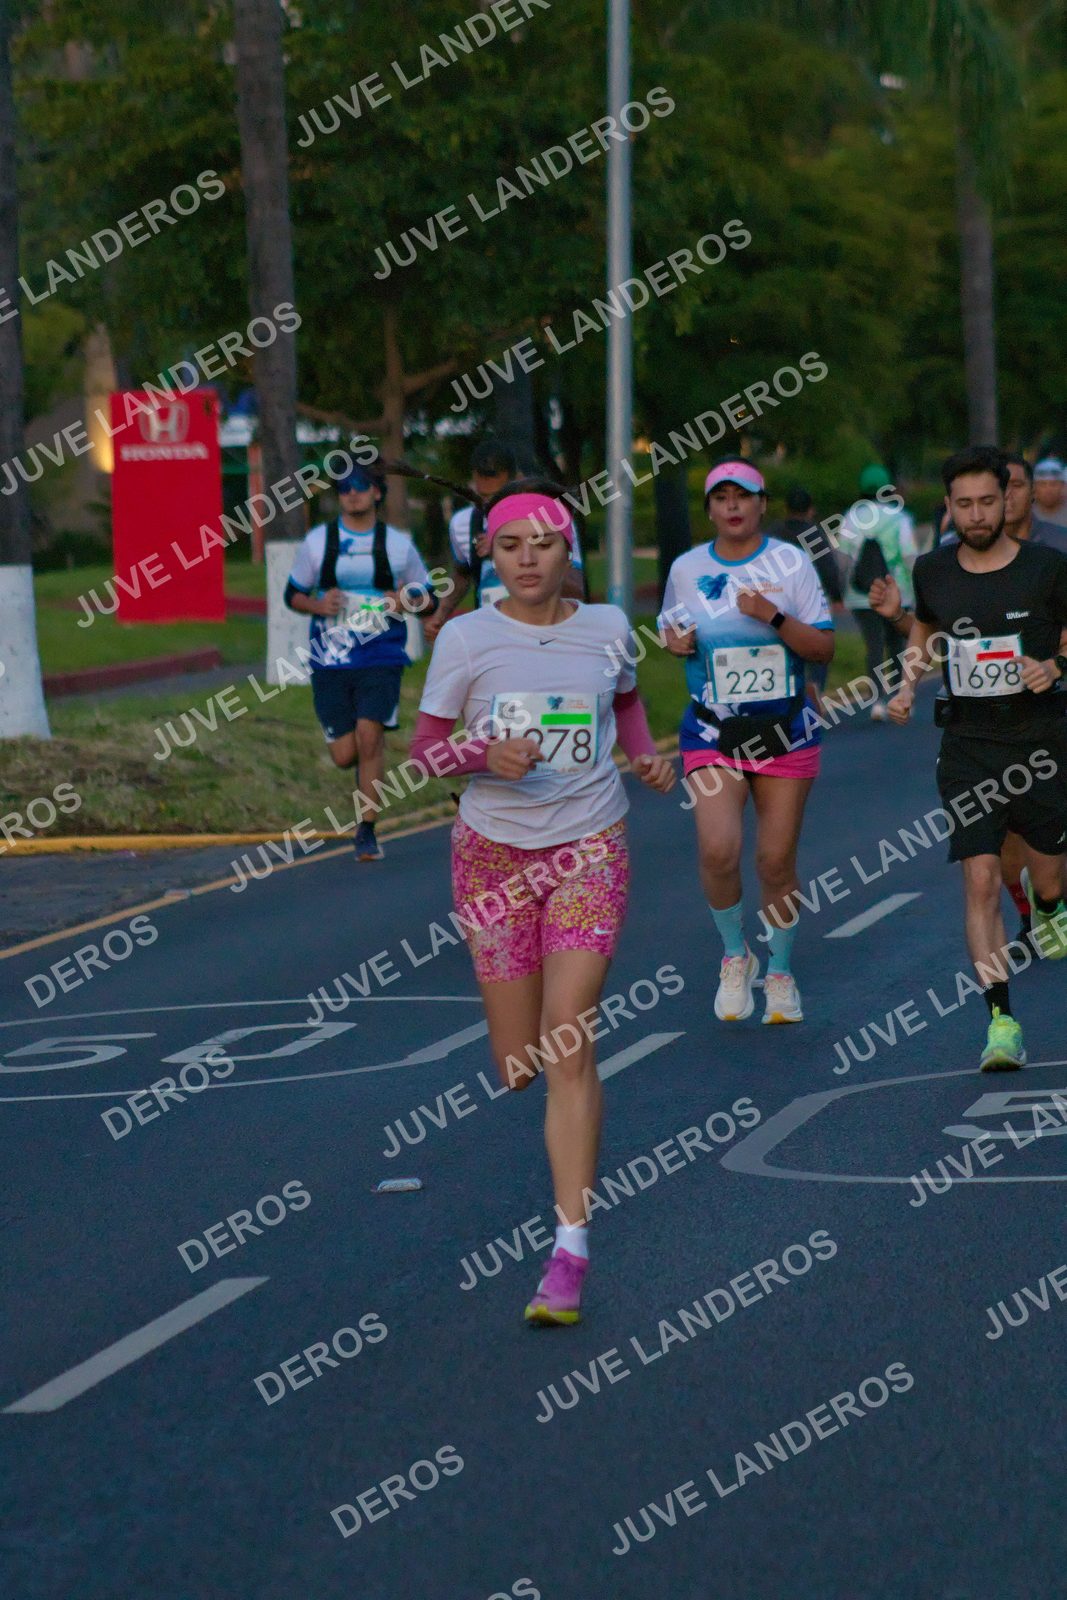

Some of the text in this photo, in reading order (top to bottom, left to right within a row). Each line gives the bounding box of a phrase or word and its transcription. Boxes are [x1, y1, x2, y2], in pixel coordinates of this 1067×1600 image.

[121, 442, 208, 461] HONDA
[726, 668, 775, 695] 223
[953, 661, 1020, 689] 1698
[503, 727, 592, 764] 78
